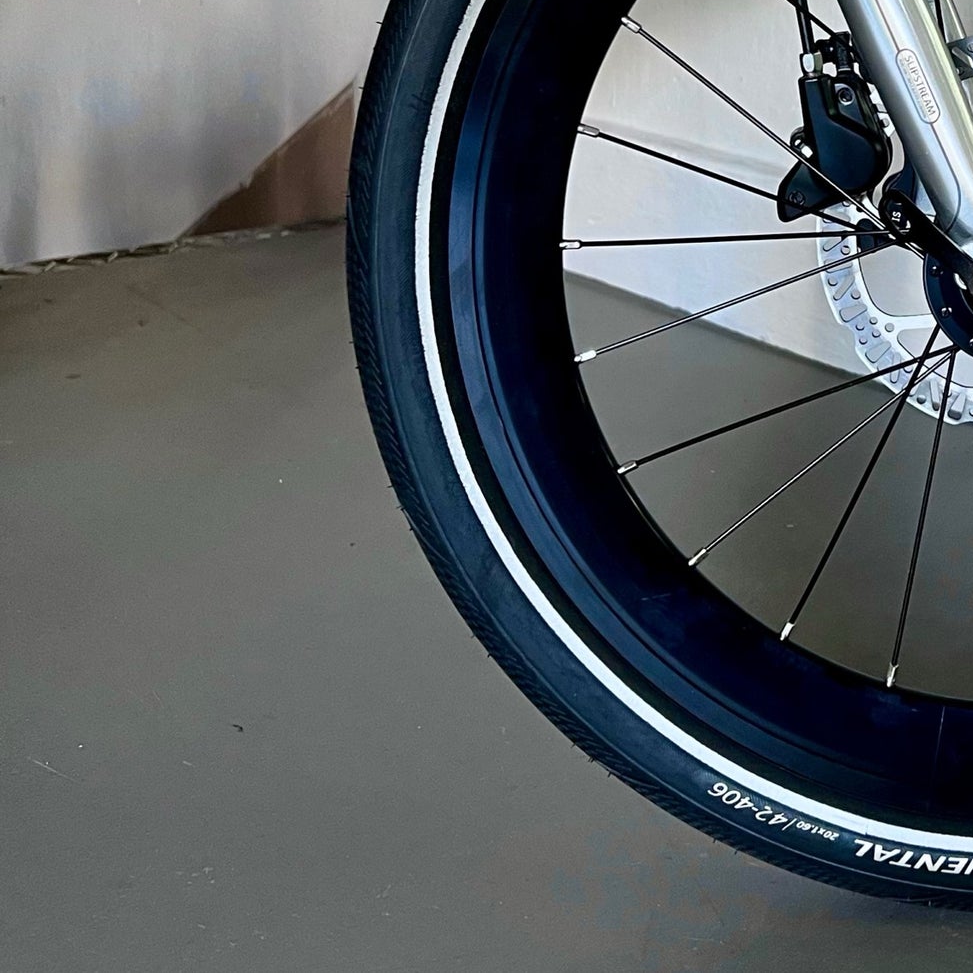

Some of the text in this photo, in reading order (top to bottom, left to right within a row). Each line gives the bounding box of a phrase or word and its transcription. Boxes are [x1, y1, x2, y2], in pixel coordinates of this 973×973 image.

[904, 55, 936, 116] SLIPSTREAM
[707, 782, 788, 826] 42-406
[796, 820, 840, 841] 20x1.60
